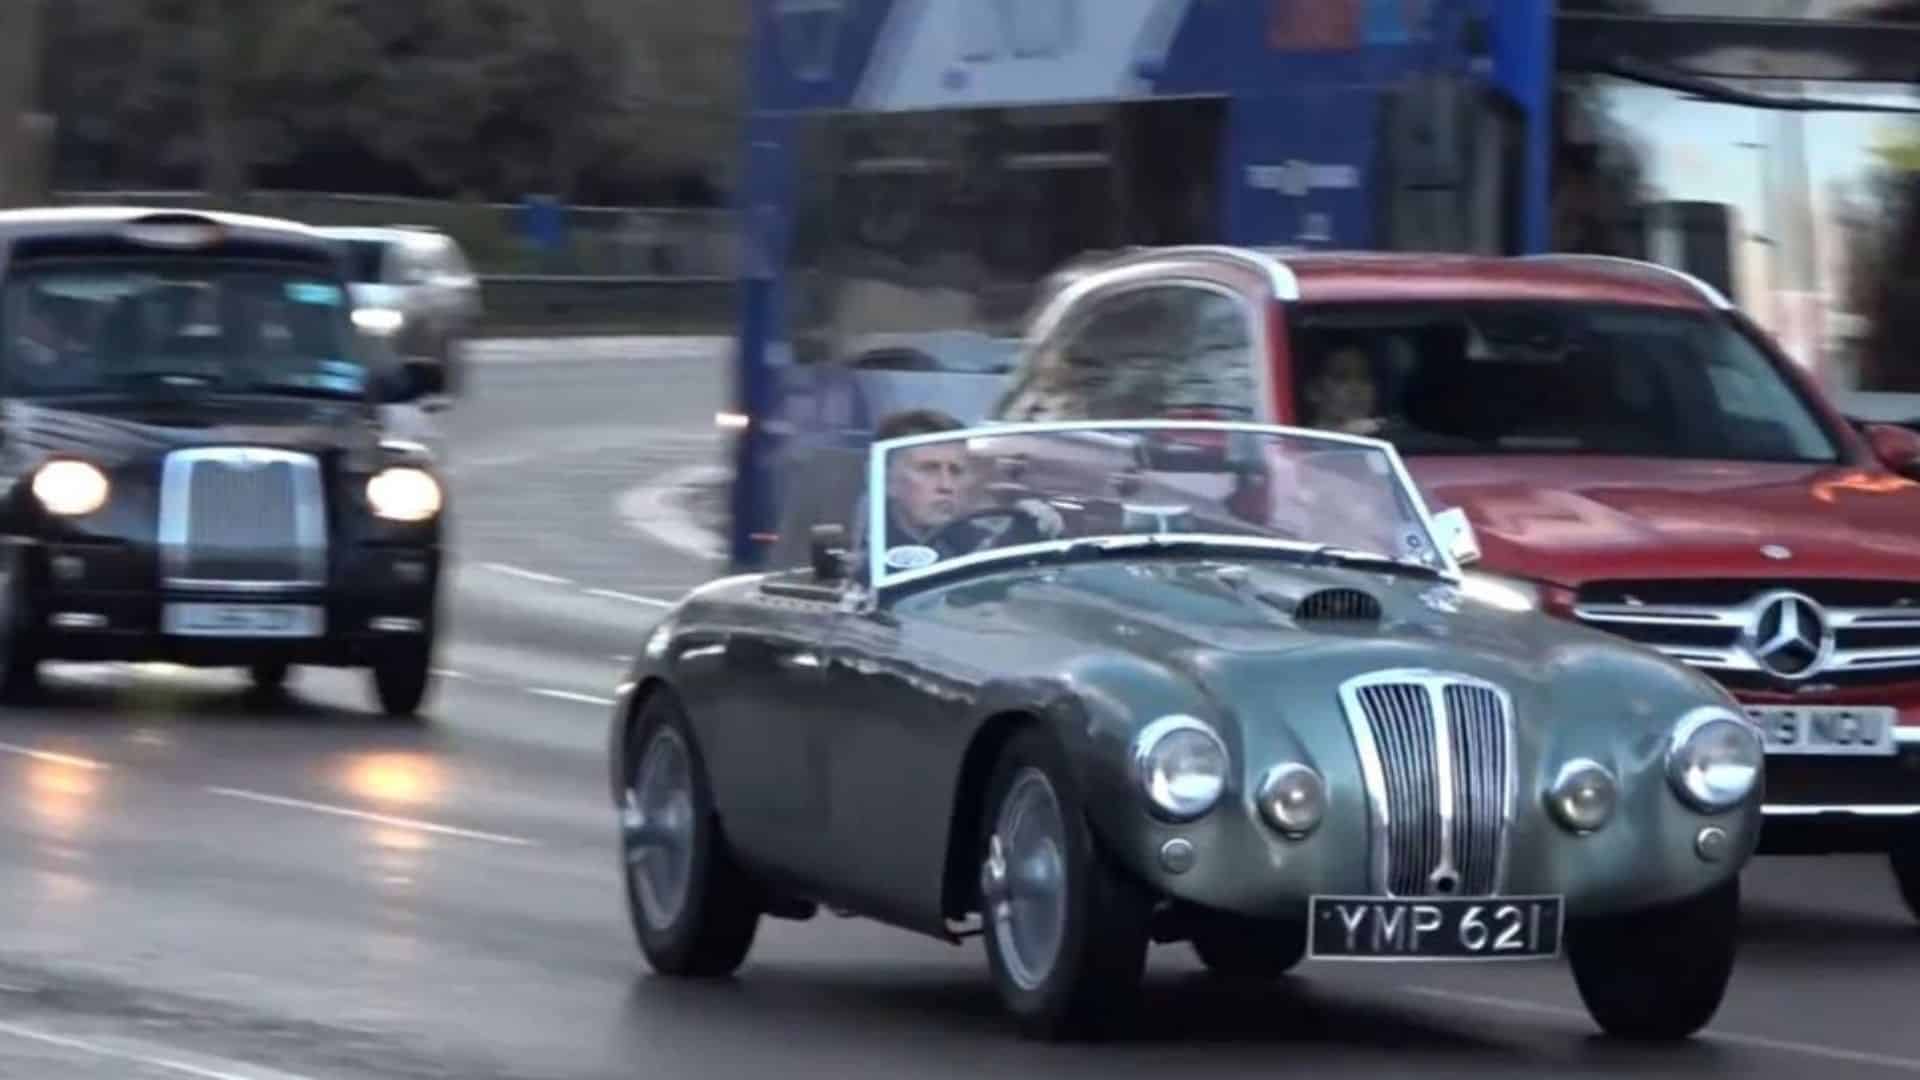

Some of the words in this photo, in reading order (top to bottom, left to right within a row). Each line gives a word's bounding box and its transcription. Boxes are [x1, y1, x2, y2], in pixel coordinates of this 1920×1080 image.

[1747, 710, 1797, 746] 19
[1336, 904, 1443, 950] YMP
[1459, 904, 1541, 950] 621
